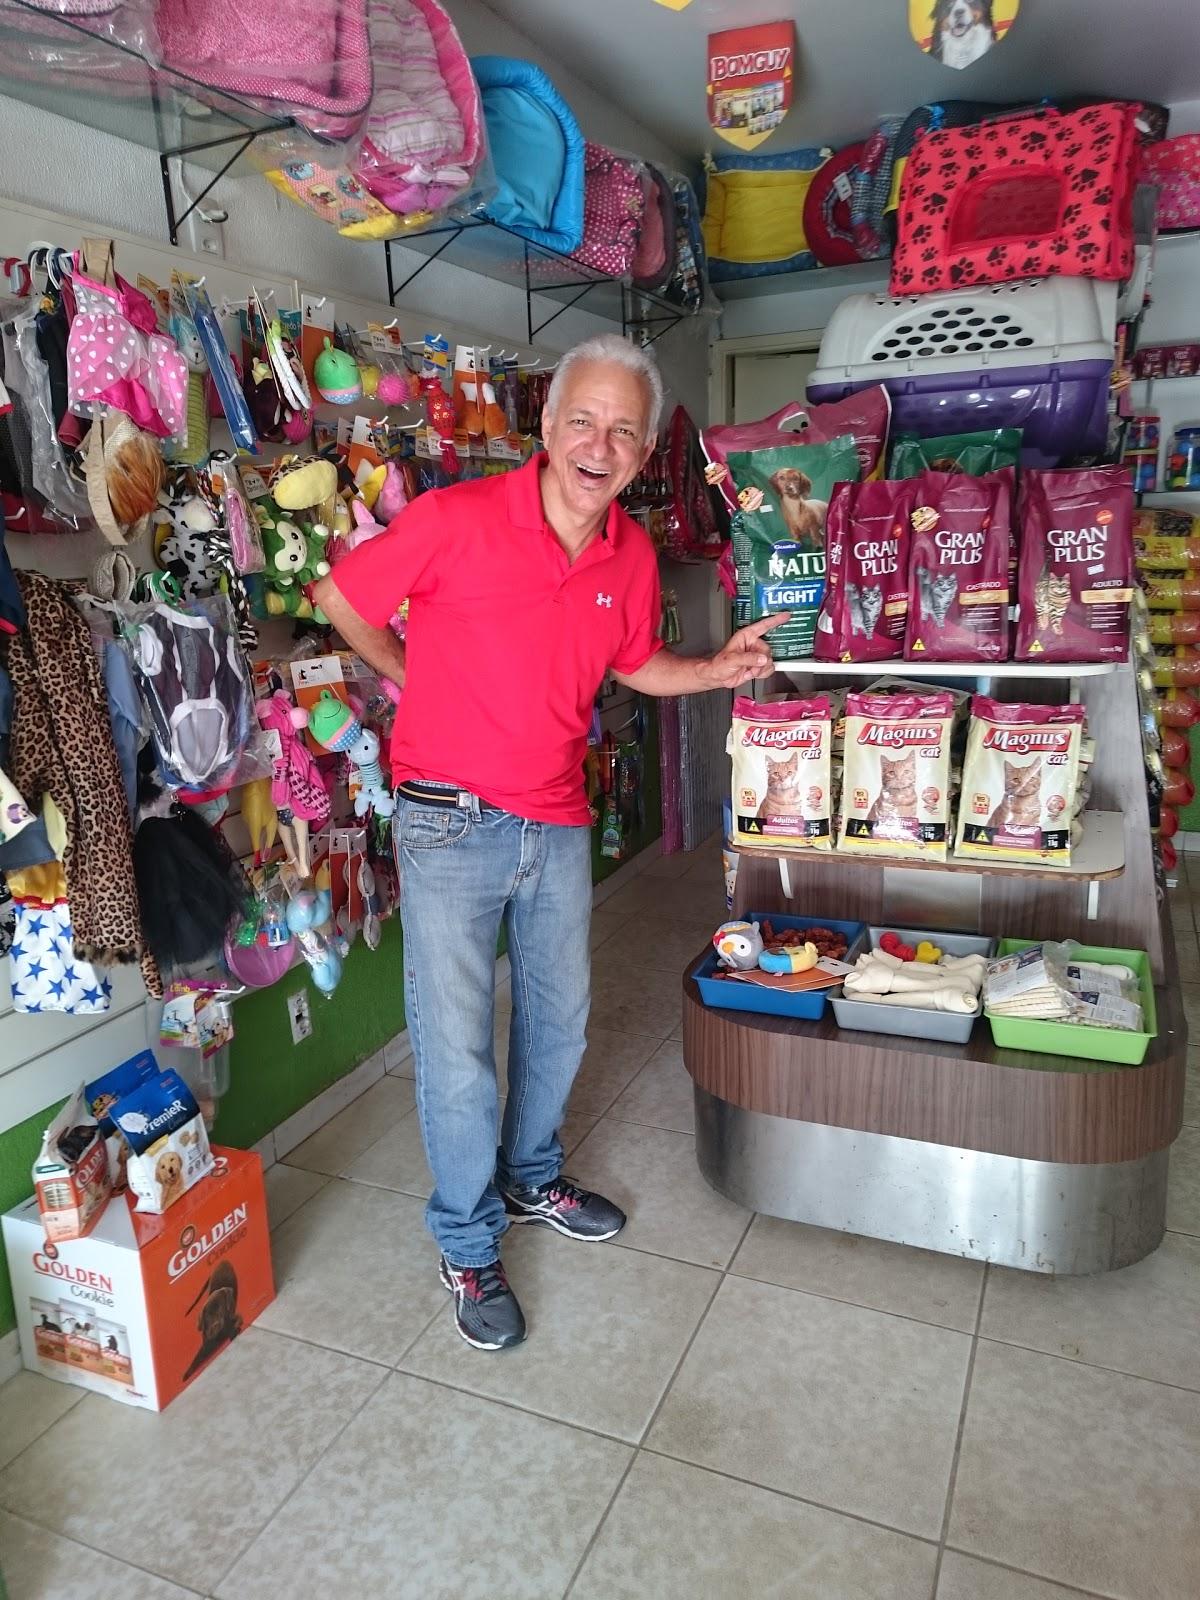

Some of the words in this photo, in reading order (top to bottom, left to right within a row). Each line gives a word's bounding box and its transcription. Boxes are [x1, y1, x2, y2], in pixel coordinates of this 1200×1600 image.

[710, 48, 790, 81] BOMGUY
[934, 530, 986, 549] GRAN
[1046, 525, 1108, 547] GRAN
[853, 538, 899, 561] GRAN
[939, 547, 983, 565] PLUS
[1054, 543, 1106, 563] PLUS
[861, 556, 899, 576] PLUS
[965, 581, 1002, 591] CASTRADO
[1091, 579, 1124, 589] ADULTO
[767, 589, 817, 605] LIGHT
[742, 727, 819, 750] Magnus
[857, 725, 938, 748] Magnus
[983, 730, 1066, 753] Magnus
[801, 747, 822, 760] cat
[920, 746, 941, 758] cat
[1047, 753, 1069, 766] cat
[771, 815, 800, 825] Adultos
[167, 1202, 248, 1278] GOLDEN
[32, 1252, 113, 1293] GOLDEN
[70, 1284, 115, 1308] Cookie
